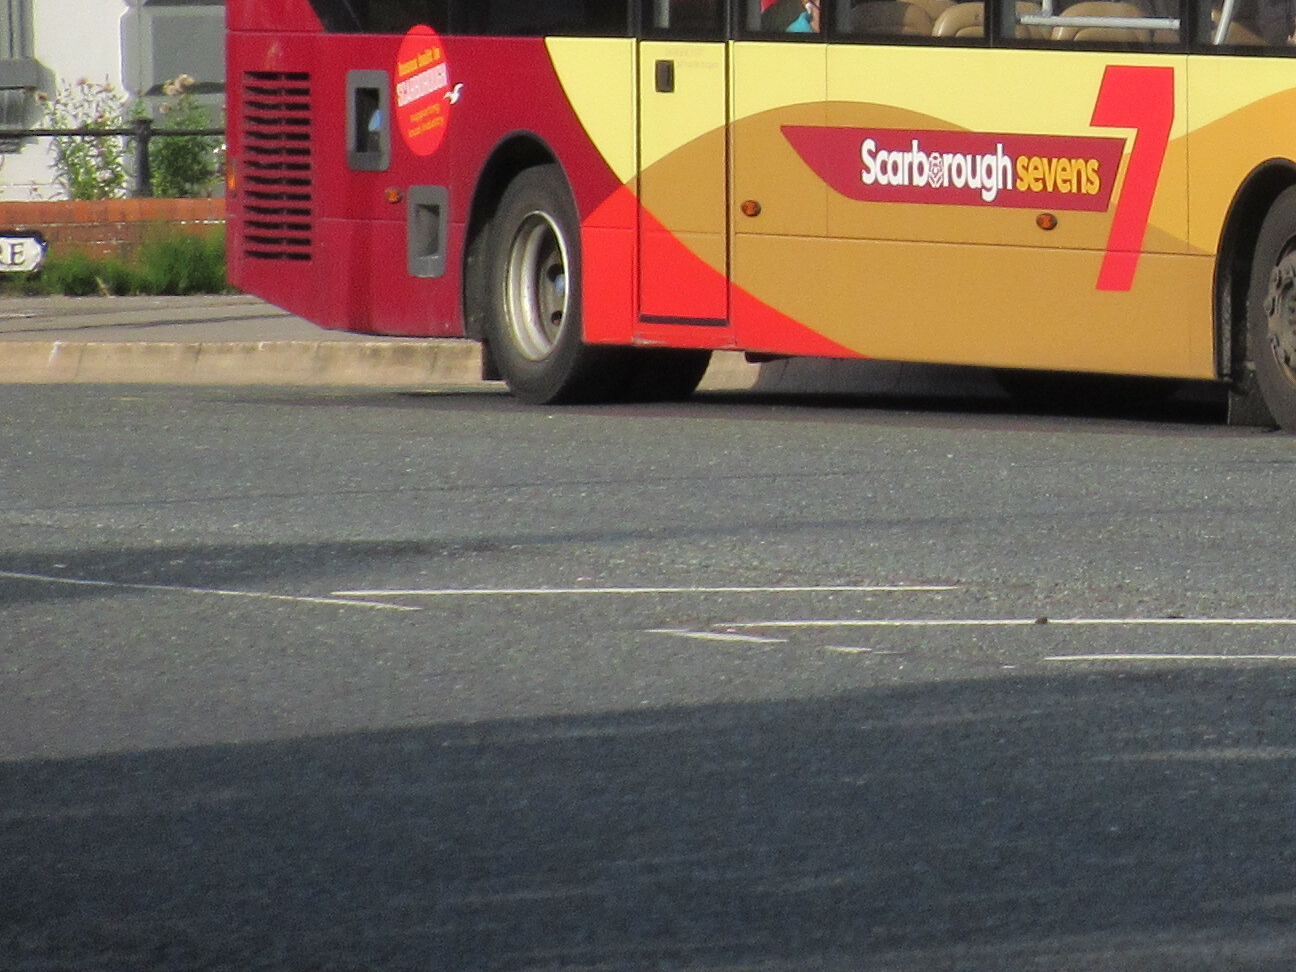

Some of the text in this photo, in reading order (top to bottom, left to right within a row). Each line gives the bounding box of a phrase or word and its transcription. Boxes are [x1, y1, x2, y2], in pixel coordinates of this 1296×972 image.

[860, 138, 1100, 202] Scarborough sevens
[1090, 65, 1175, 291] 7
